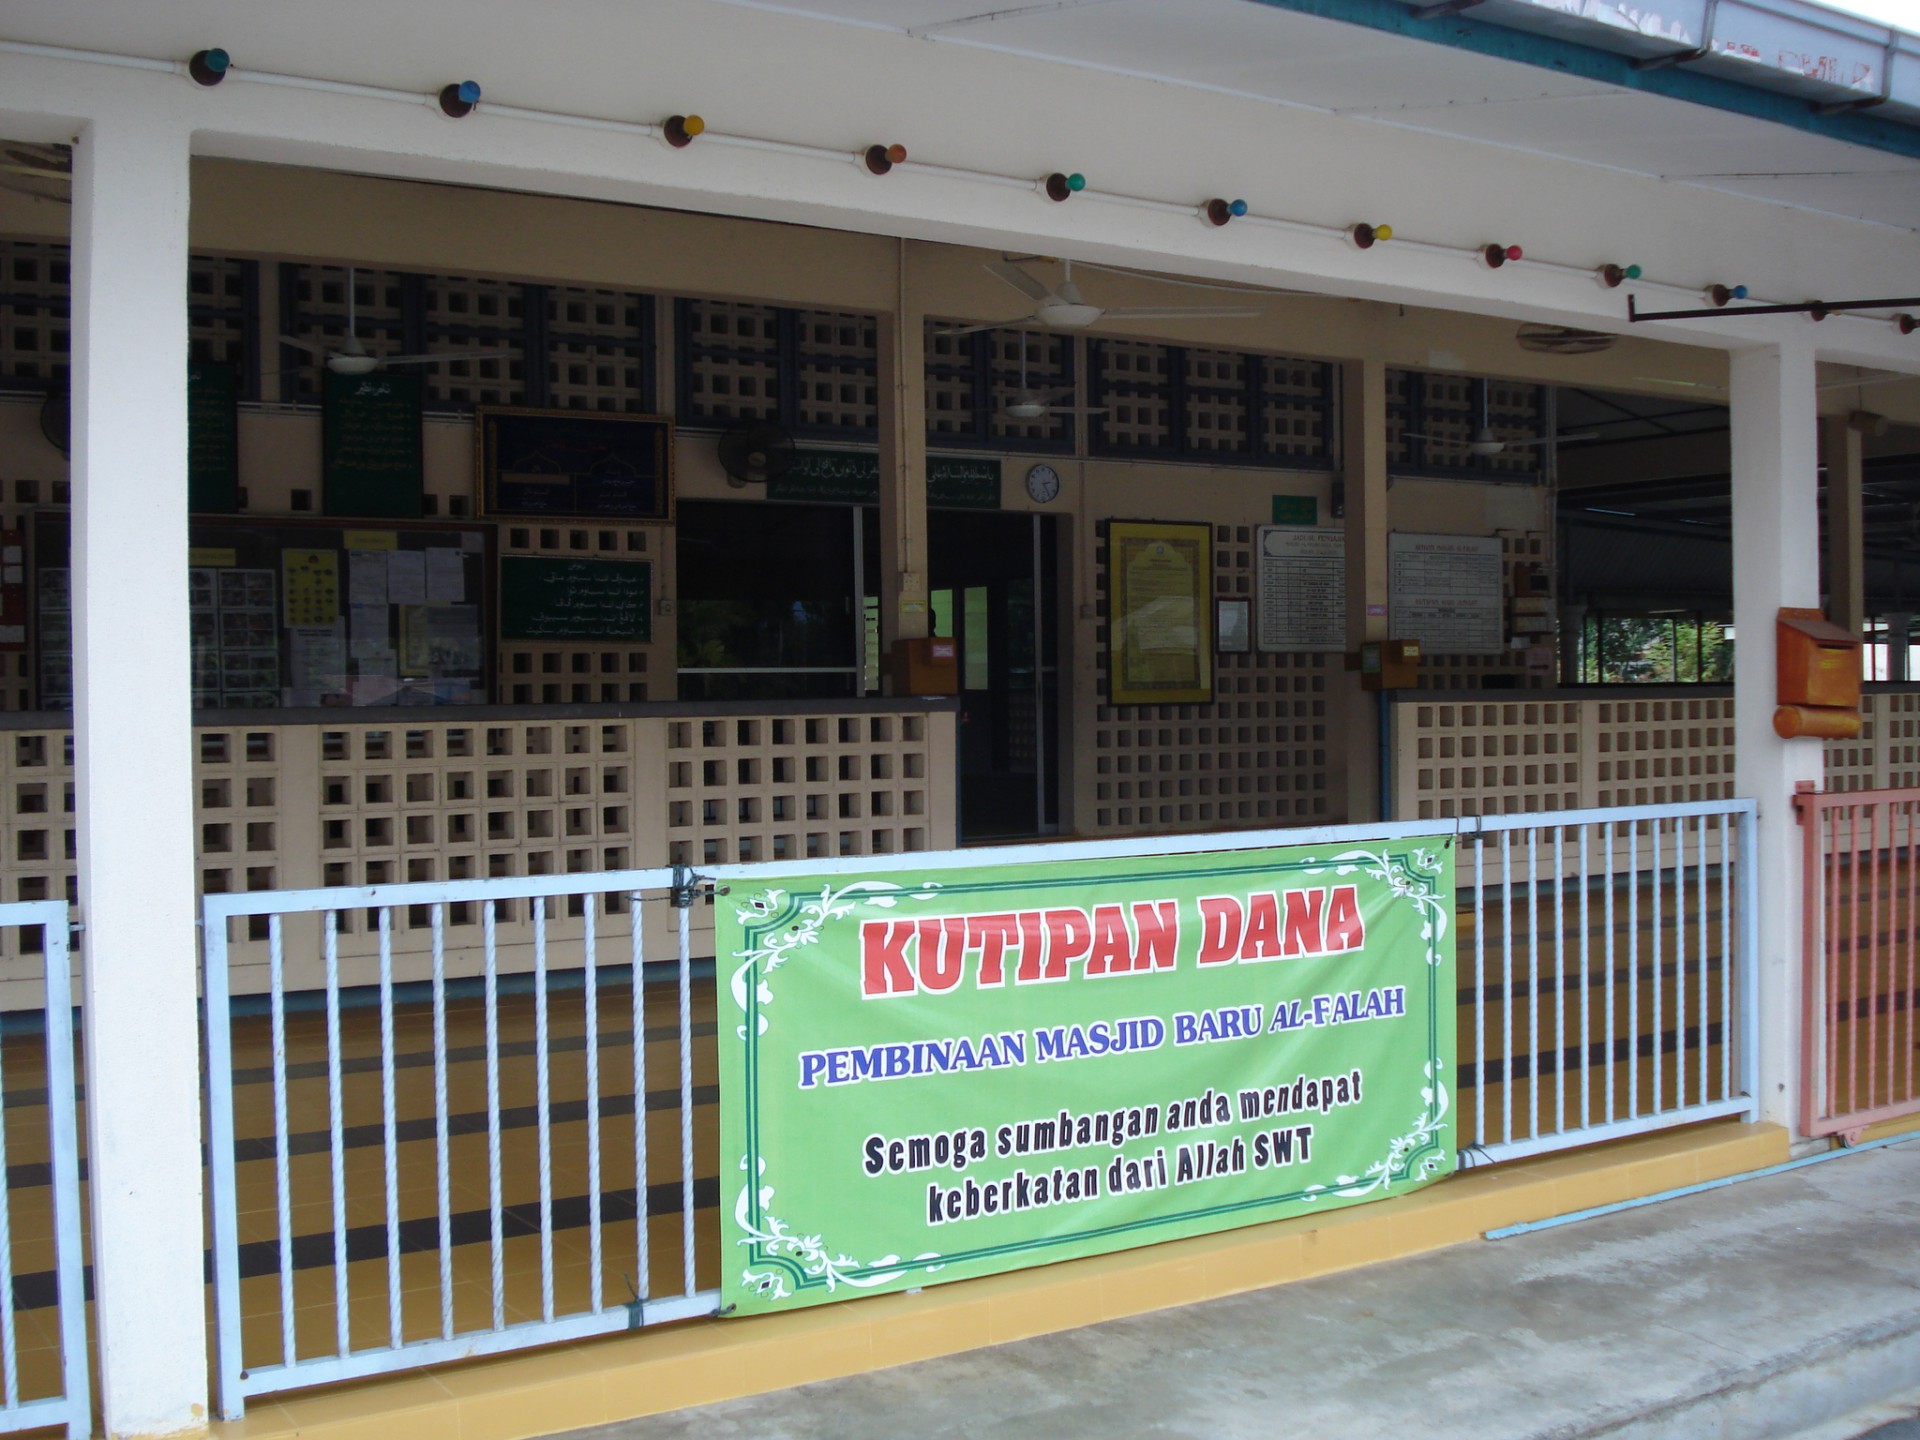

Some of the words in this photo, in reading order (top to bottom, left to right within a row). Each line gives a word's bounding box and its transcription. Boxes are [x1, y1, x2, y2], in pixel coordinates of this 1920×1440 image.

[860, 899, 1179, 999] KUTIPAN
[1197, 884, 1364, 968] DANA
[799, 1030, 1026, 1088] PEMBINAAN
[1035, 1016, 1166, 1061] MASJID
[1174, 1006, 1262, 1044] BARU
[1269, 988, 1406, 1034] AL-FALAH
[864, 1128, 985, 1177] Semoga
[997, 1103, 1158, 1157] sumbangan
[1166, 1091, 1230, 1130] anda
[1239, 1070, 1362, 1118] mendapat
[927, 1164, 1098, 1225] keberkatan
[1107, 1148, 1166, 1194] dari
[1175, 1138, 1244, 1184] Allah
[1253, 1126, 1312, 1170] SWT
